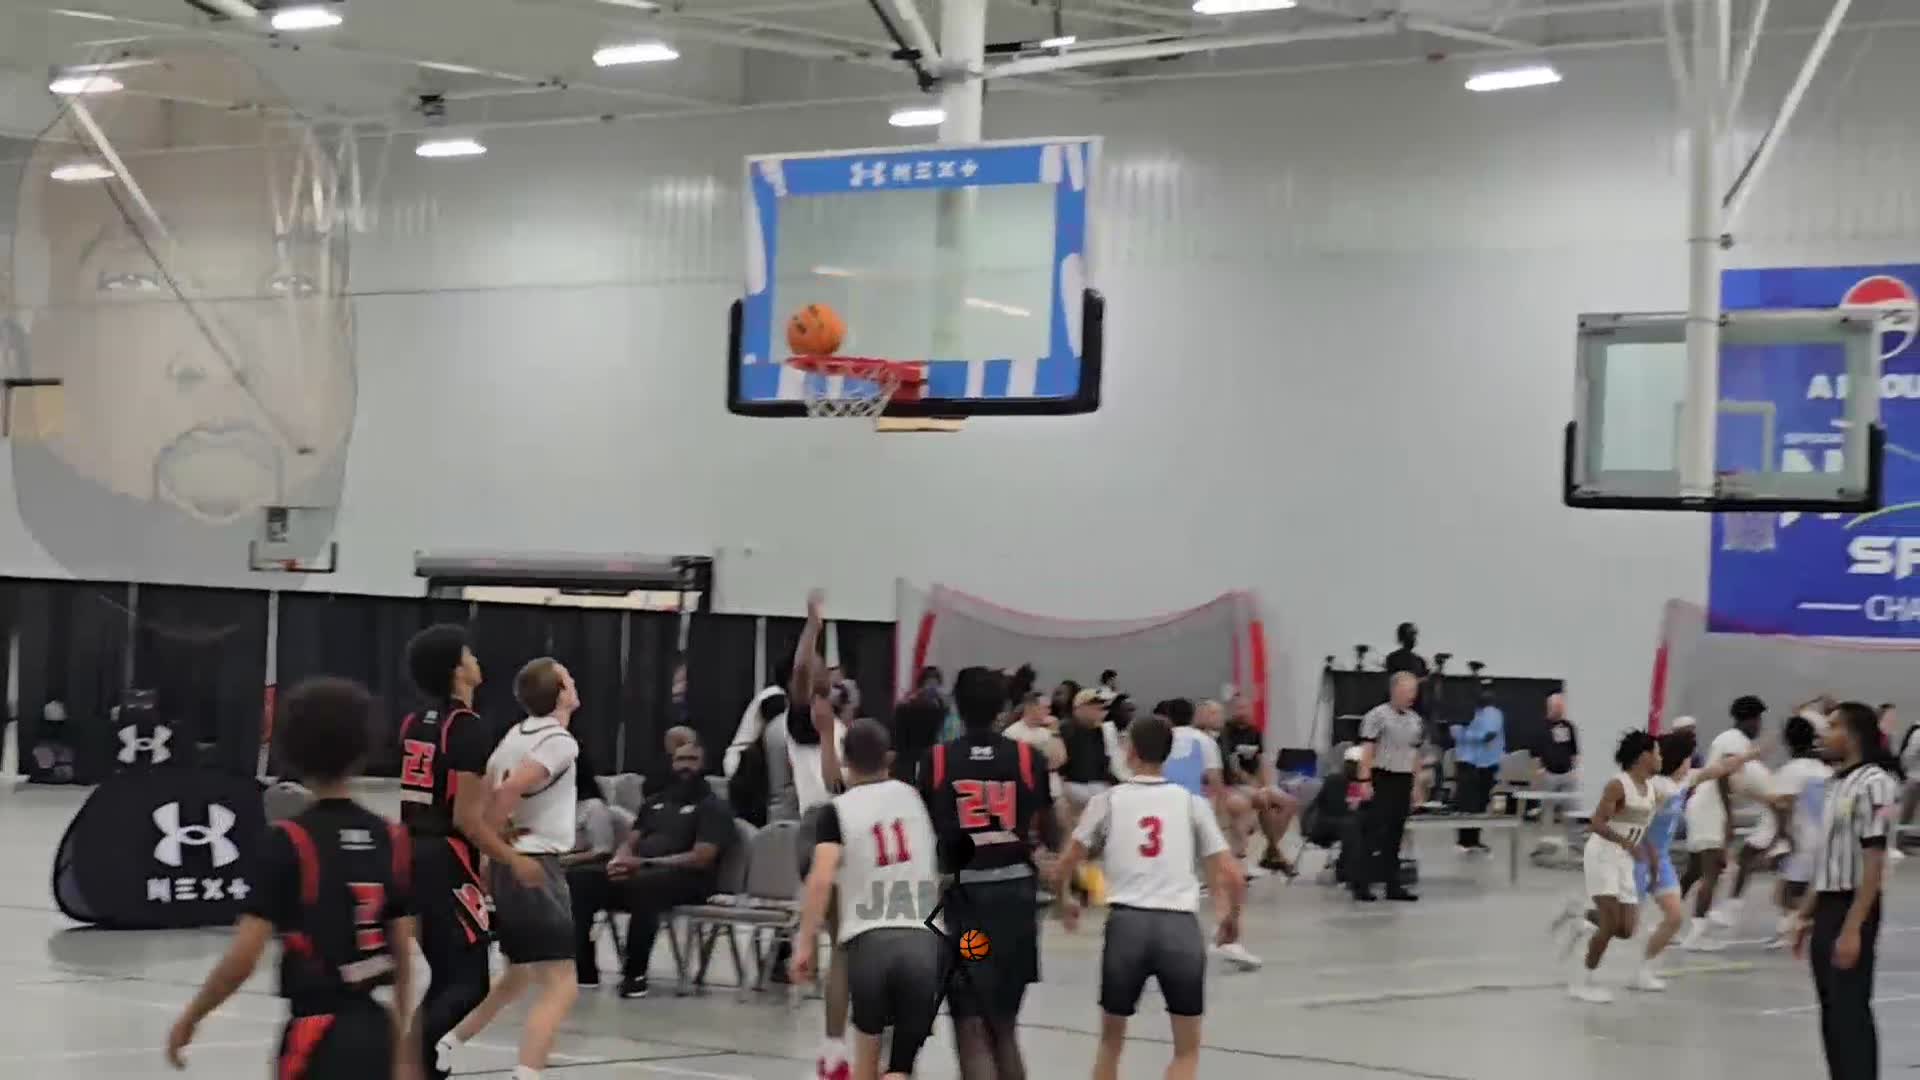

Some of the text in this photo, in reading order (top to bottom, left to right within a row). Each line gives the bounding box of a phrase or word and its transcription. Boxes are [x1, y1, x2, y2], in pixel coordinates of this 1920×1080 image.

[402, 739, 435, 787] 23
[952, 780, 1016, 830] 24
[872, 820, 911, 867] 11
[1138, 816, 1163, 858] 3
